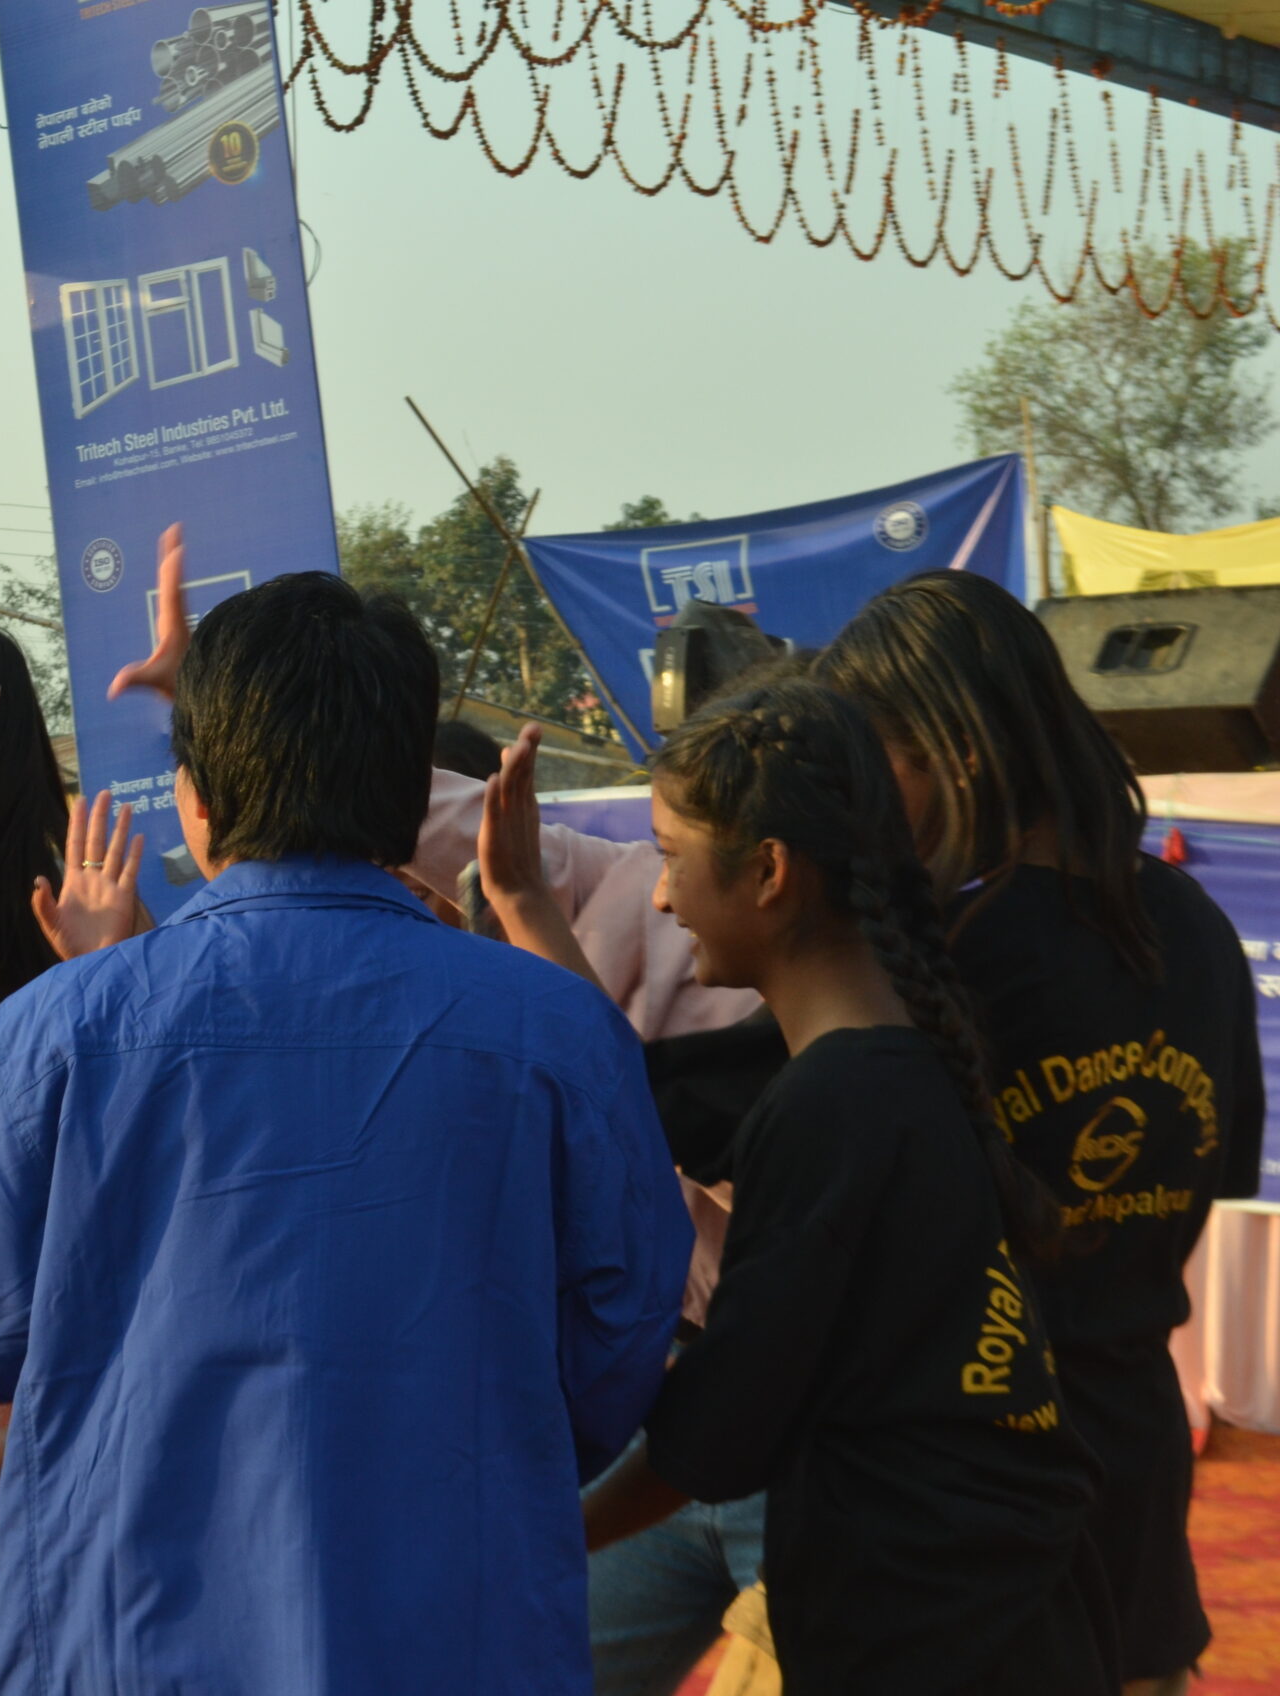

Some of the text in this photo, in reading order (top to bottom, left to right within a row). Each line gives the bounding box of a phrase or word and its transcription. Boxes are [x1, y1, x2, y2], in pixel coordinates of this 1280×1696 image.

[35, 106, 79, 129] नेपालमा
[37, 106, 143, 150] नेपाली स्टील पाईप
[220, 131, 242, 158] 10
[75, 398, 290, 463] Tritech Steel Industries Pvt. Ltd.
[110, 777, 154, 796] नेपालमा
[1040, 1041, 1143, 1103] Dance
[961, 1266, 1029, 1395] Royal
